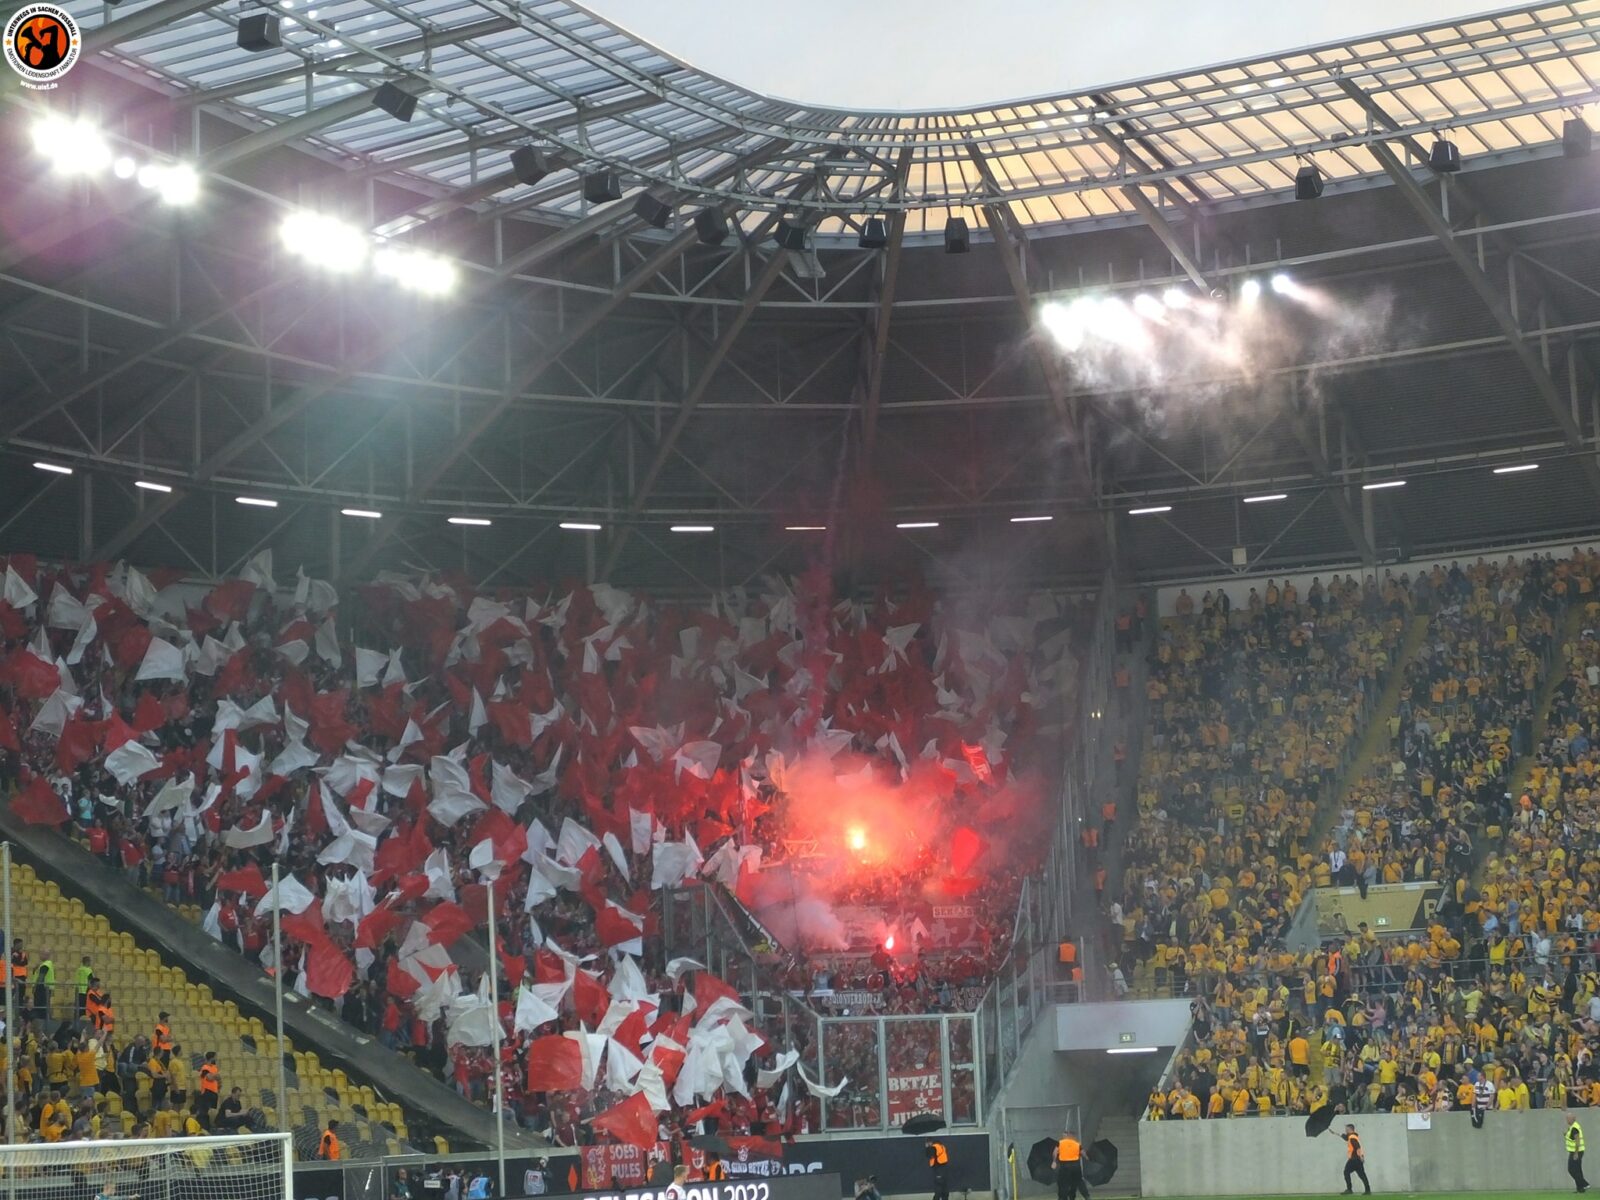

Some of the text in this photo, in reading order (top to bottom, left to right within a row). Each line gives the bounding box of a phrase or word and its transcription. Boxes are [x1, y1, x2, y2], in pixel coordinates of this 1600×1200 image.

[888, 1074, 942, 1091] BETZE
[608, 1143, 639, 1160] SOEST
[611, 1162, 641, 1179] RULES
